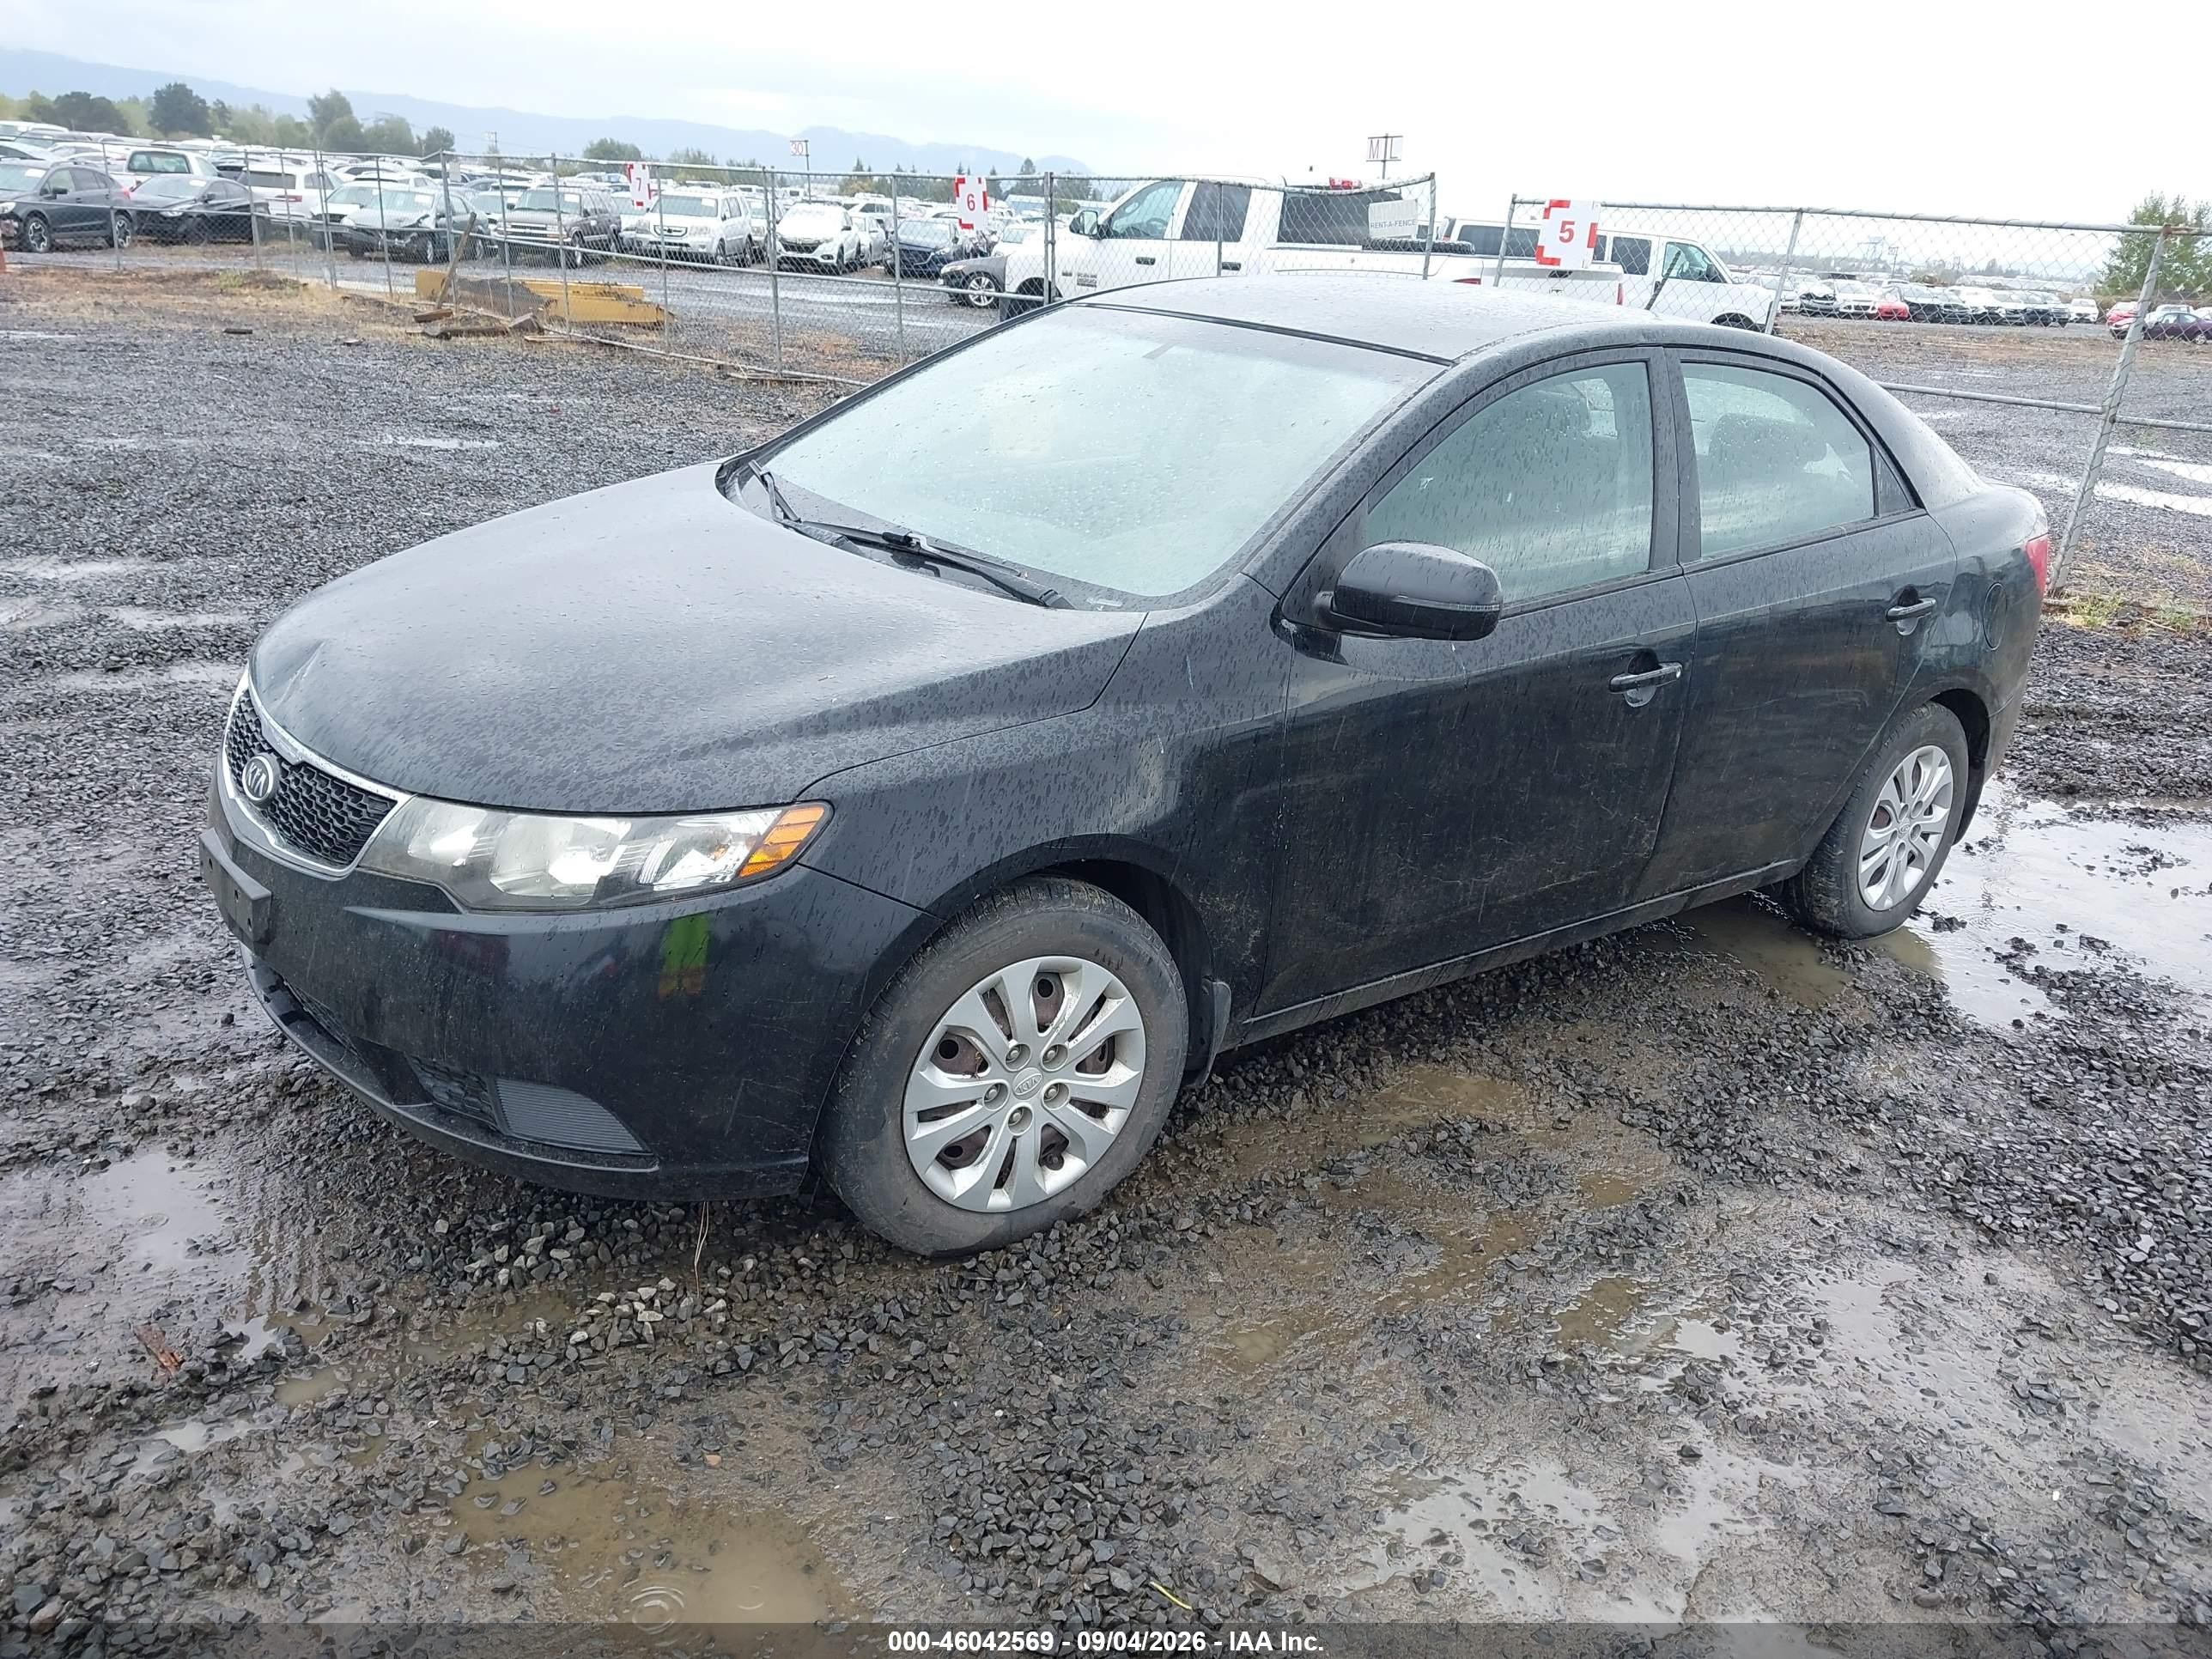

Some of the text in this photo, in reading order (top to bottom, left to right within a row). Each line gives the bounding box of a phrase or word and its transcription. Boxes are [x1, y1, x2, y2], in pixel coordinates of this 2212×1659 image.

[635, 177, 642, 191] 7
[967, 193, 975, 211] 6
[1370, 218, 1417, 228] RENT-A-FENCE
[1559, 220, 1575, 243] 5
[247, 762, 267, 797] KIA
[1016, 1076, 1041, 1093] KIA
